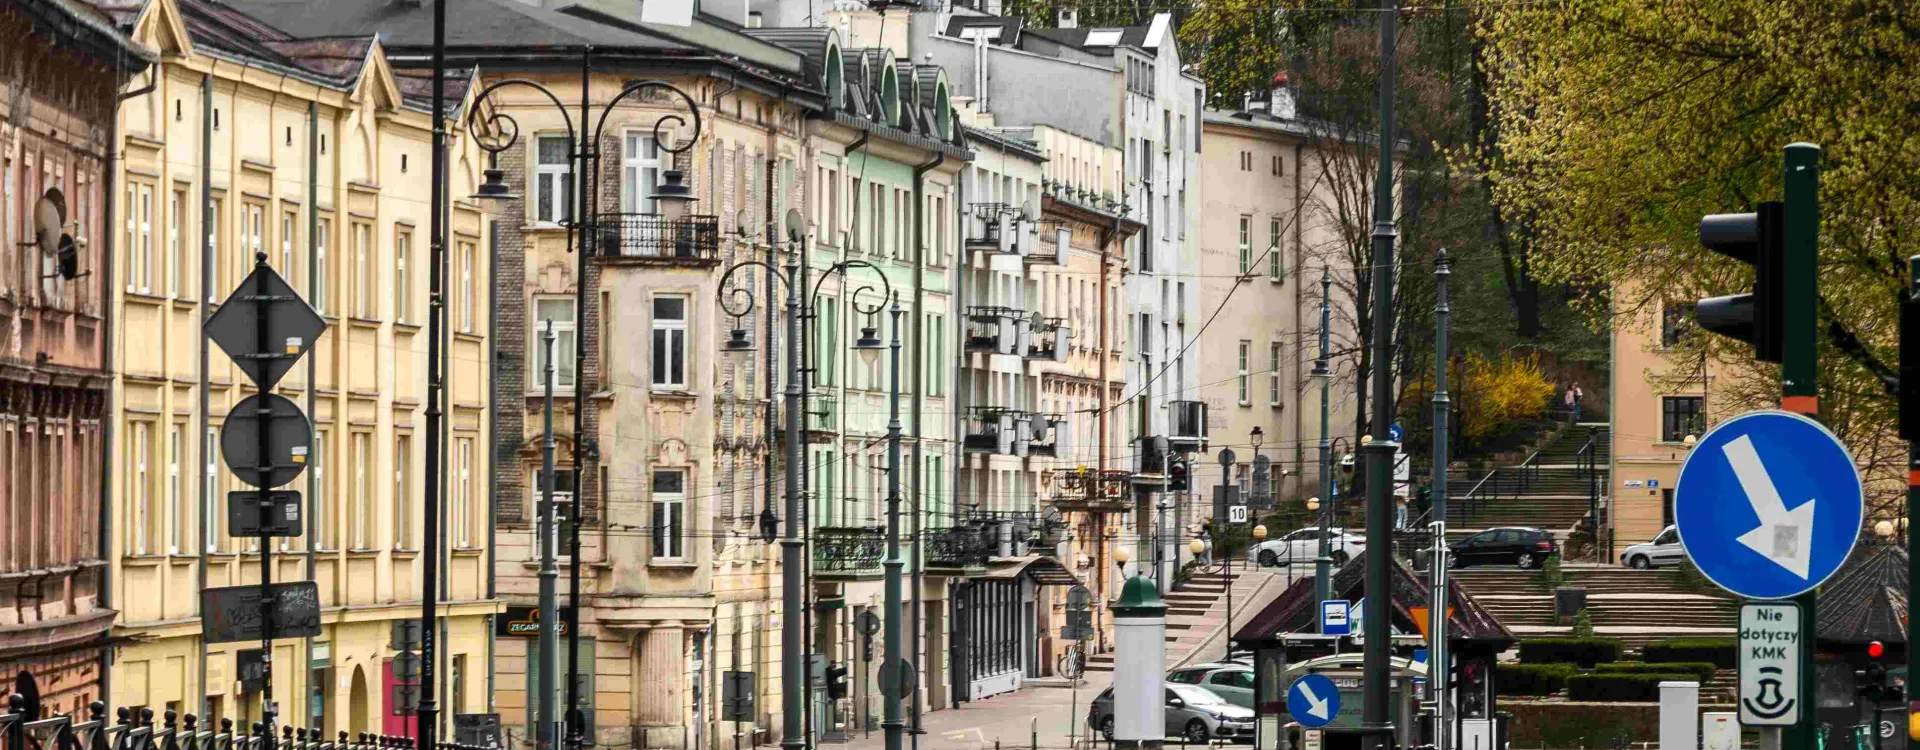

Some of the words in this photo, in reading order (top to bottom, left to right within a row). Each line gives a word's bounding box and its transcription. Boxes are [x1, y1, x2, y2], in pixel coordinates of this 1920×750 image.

[1231, 508, 1244, 520] 10
[1757, 608, 1783, 621] Nie
[1741, 628, 1798, 644] dotyczy
[1752, 646, 1786, 659] KMK
